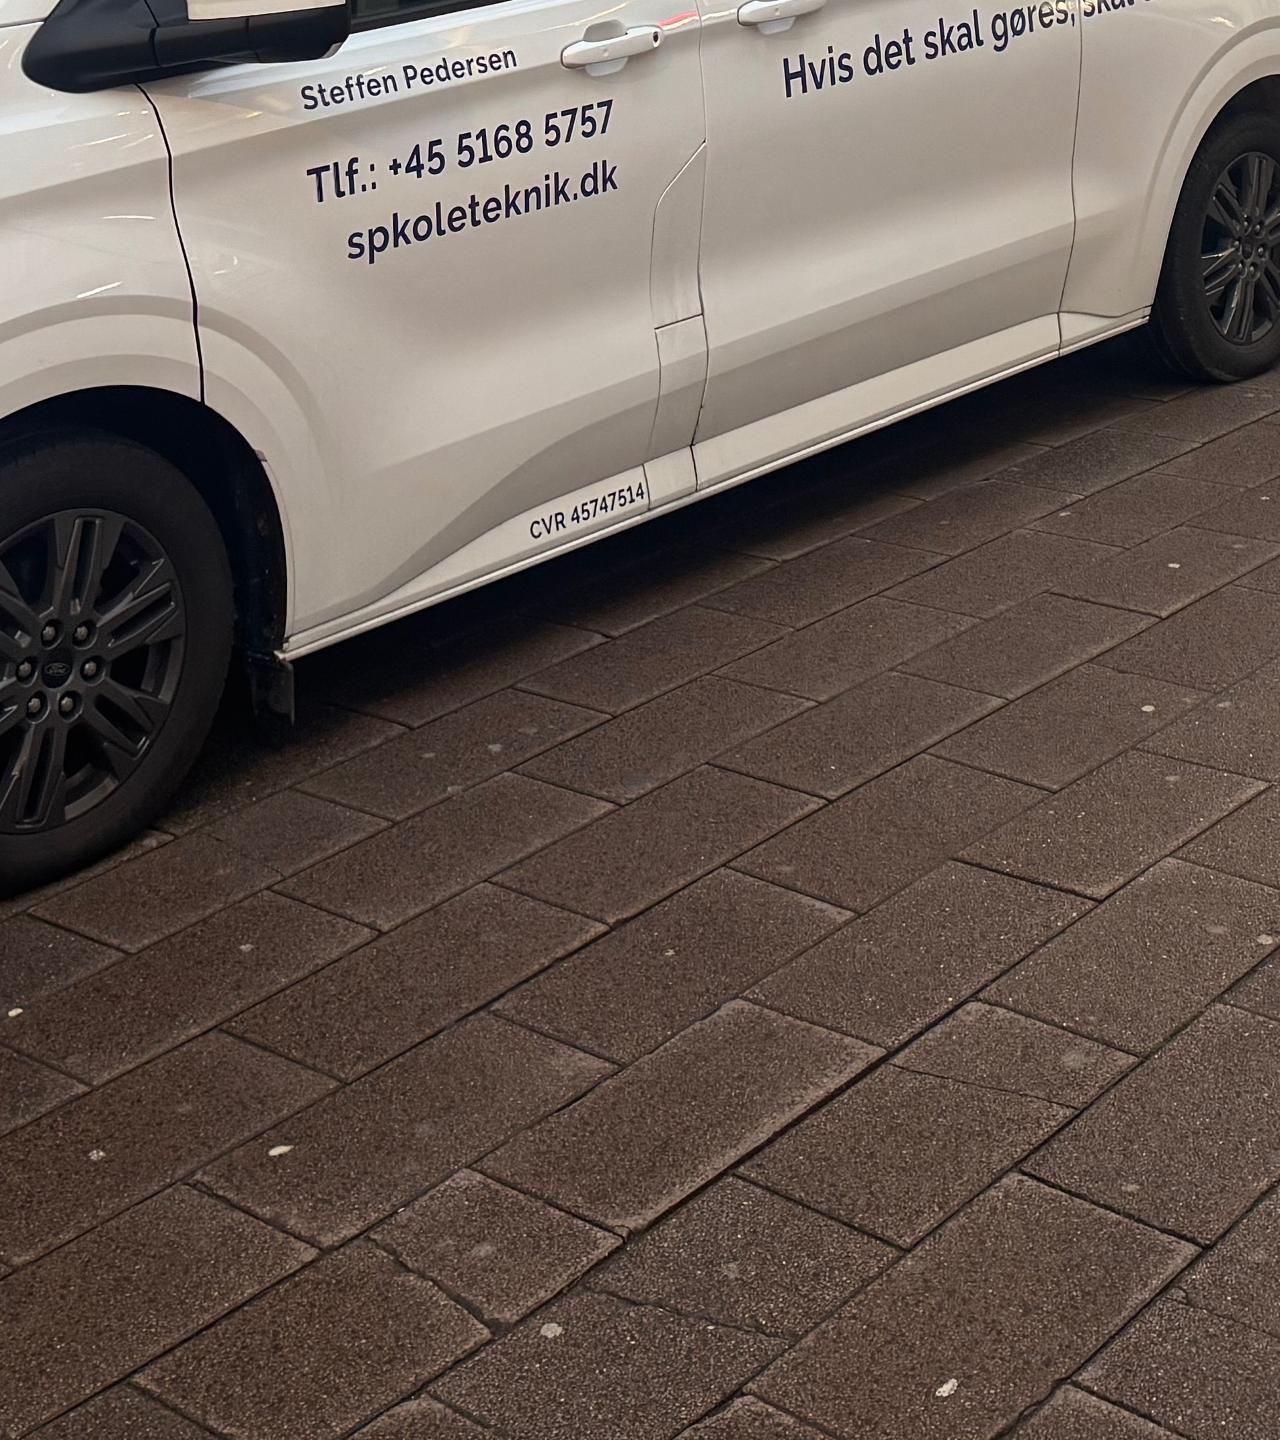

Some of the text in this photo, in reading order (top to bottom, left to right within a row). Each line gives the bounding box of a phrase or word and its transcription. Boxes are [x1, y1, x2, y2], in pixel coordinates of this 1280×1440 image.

[301, 47, 518, 111] Steffen Pedersen
[783, 45, 854, 98] Hvis
[863, 28, 916, 75] det
[924, 9, 984, 59] skal
[306, 99, 614, 204] Tlf.: +45 5168 5757
[347, 159, 619, 265] spkoleteknik.dk
[530, 482, 645, 539] CVR 45747514
